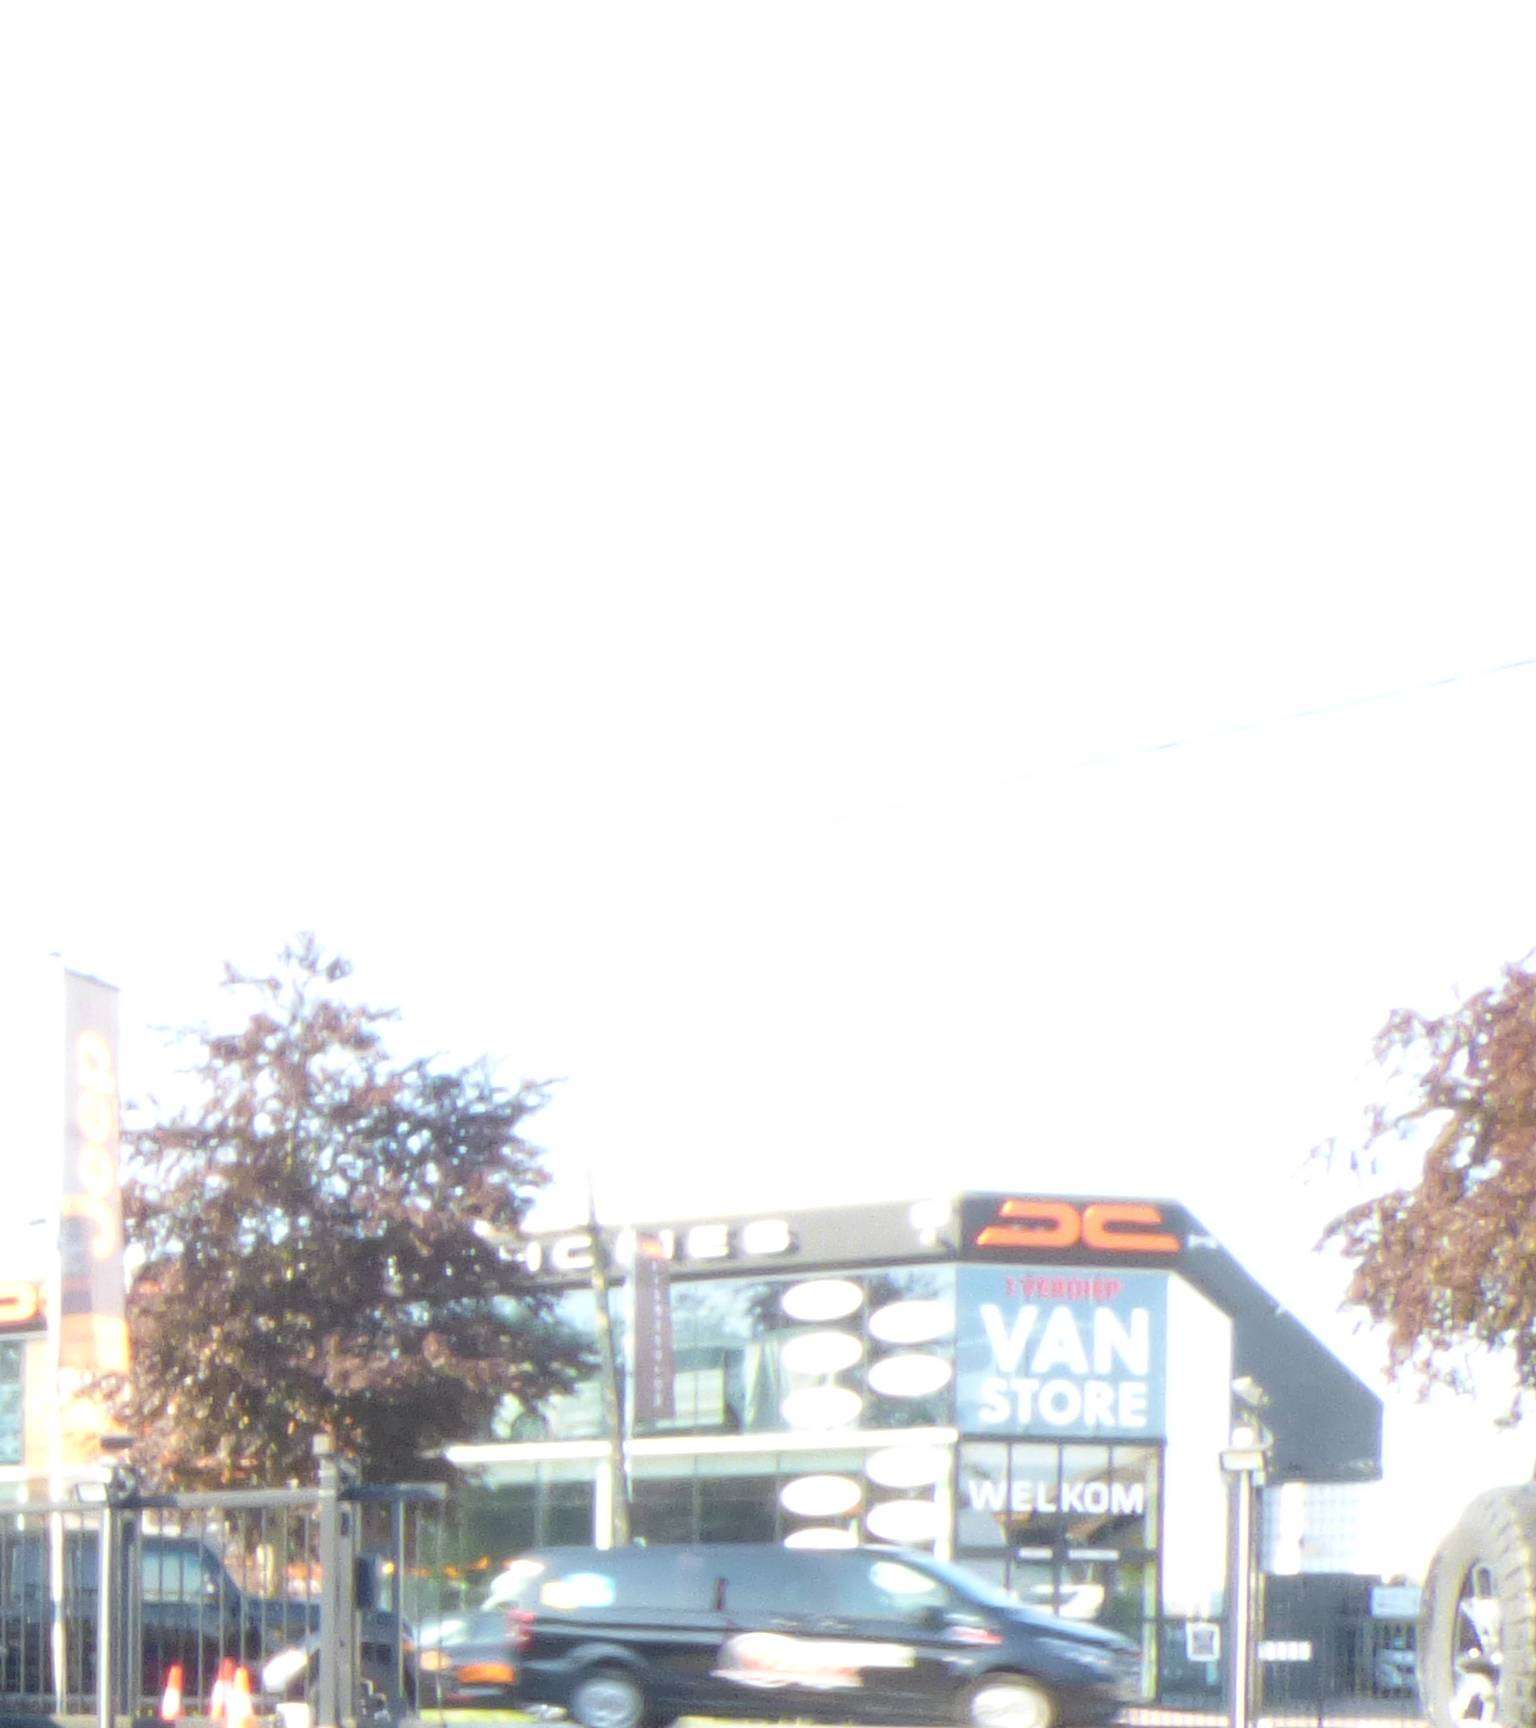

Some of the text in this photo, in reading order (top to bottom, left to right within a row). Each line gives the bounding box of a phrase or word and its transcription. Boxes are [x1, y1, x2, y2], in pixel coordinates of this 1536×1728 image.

[979, 1302, 1150, 1376] VAN
[977, 1376, 1148, 1429] STORE
[968, 1479, 1145, 1515] WELKOM
